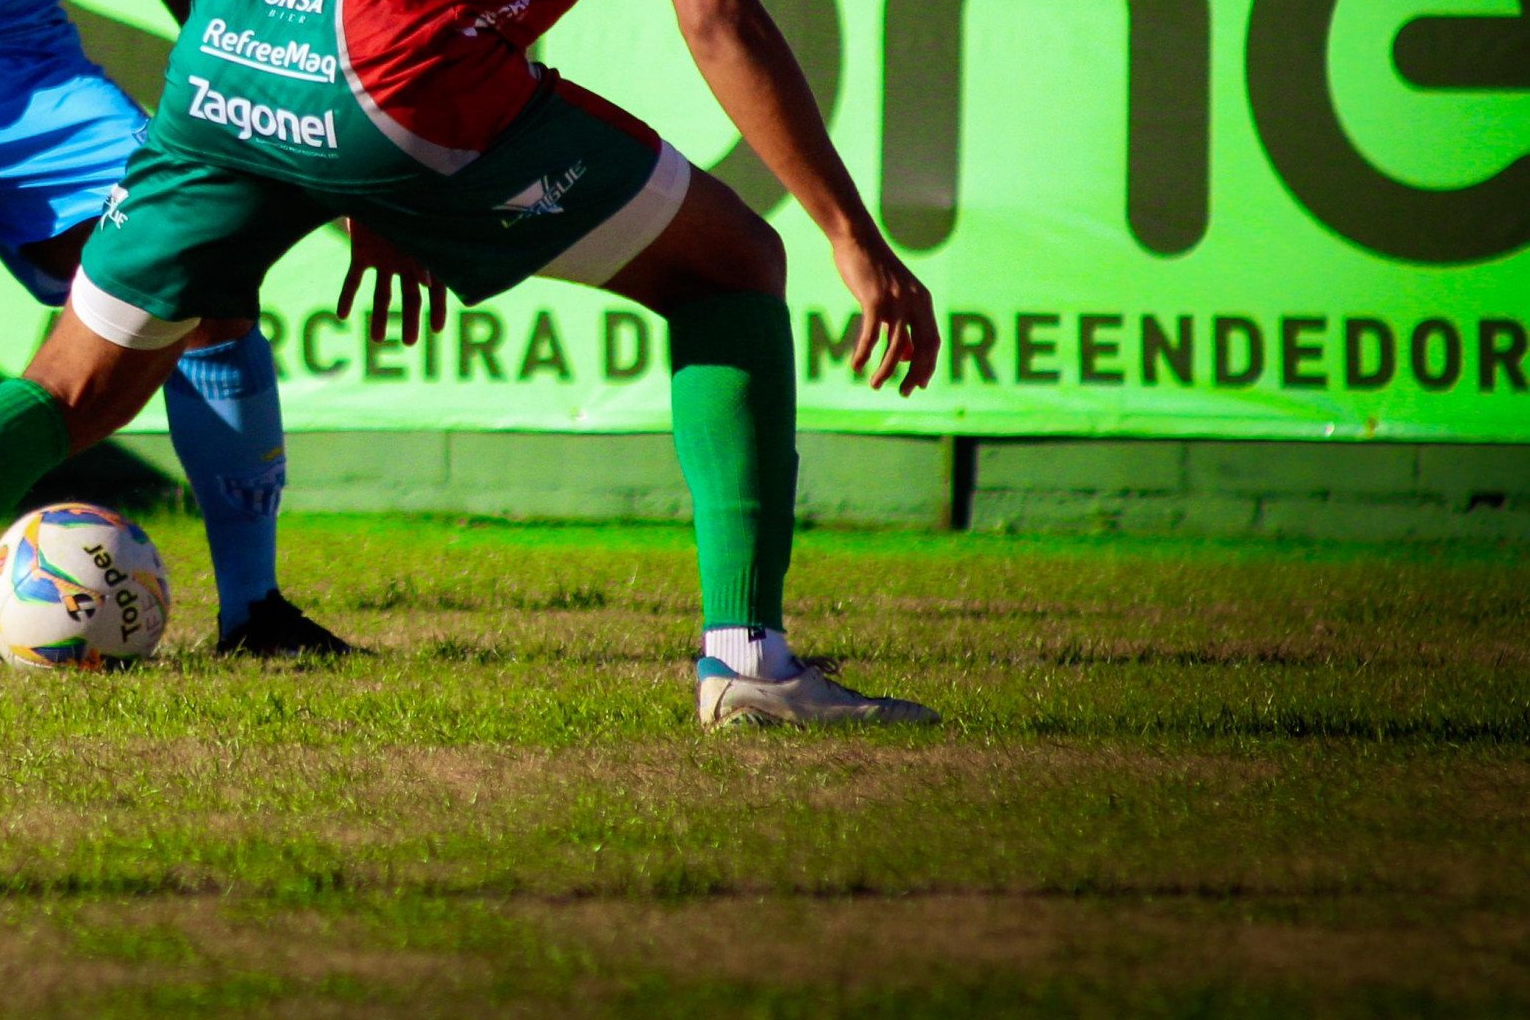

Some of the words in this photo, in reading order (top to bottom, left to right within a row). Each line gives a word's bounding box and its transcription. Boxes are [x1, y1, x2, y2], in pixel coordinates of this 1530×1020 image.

[202, 18, 337, 84] RefreeMaq
[188, 75, 338, 149] Zagonel
[83, 543, 144, 644] Topper
